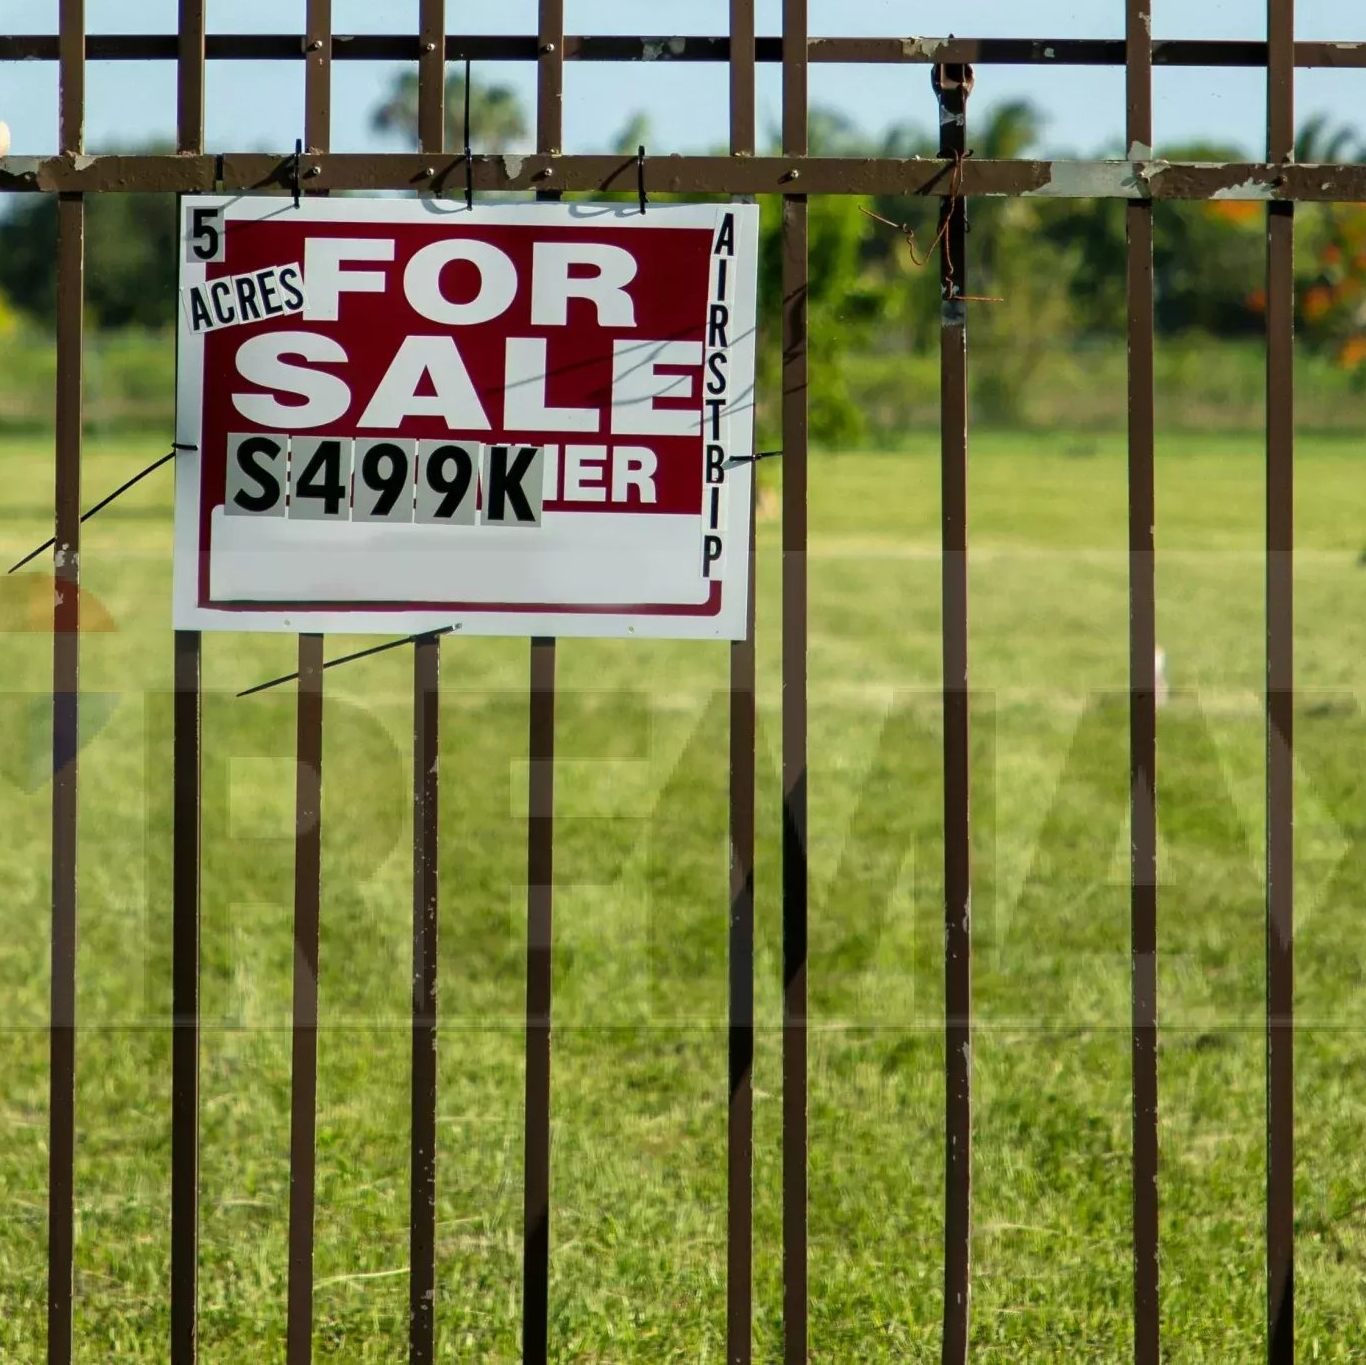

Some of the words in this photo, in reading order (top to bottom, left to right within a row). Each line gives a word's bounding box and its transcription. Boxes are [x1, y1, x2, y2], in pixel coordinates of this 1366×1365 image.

[192, 208, 219, 260] 5
[189, 267, 305, 332] ACRES
[302, 237, 638, 327] FOR
[231, 330, 703, 436] SALE
